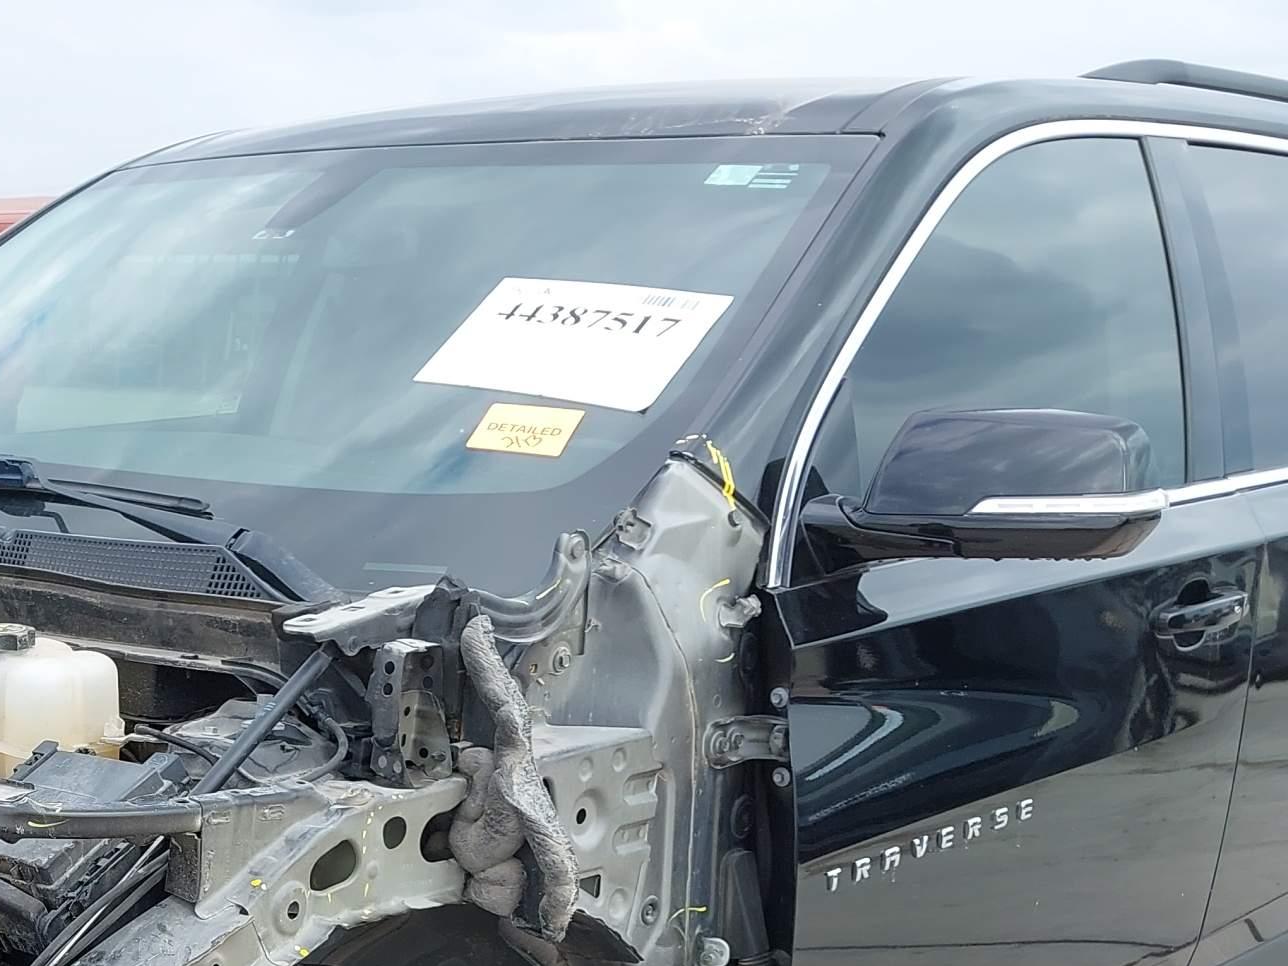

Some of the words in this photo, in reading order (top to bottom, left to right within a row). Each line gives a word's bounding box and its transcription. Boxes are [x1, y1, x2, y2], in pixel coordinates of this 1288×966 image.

[498, 303, 682, 337] 44387517
[487, 422, 563, 437] DETAILED
[825, 798, 1033, 892] TRAVERSE
